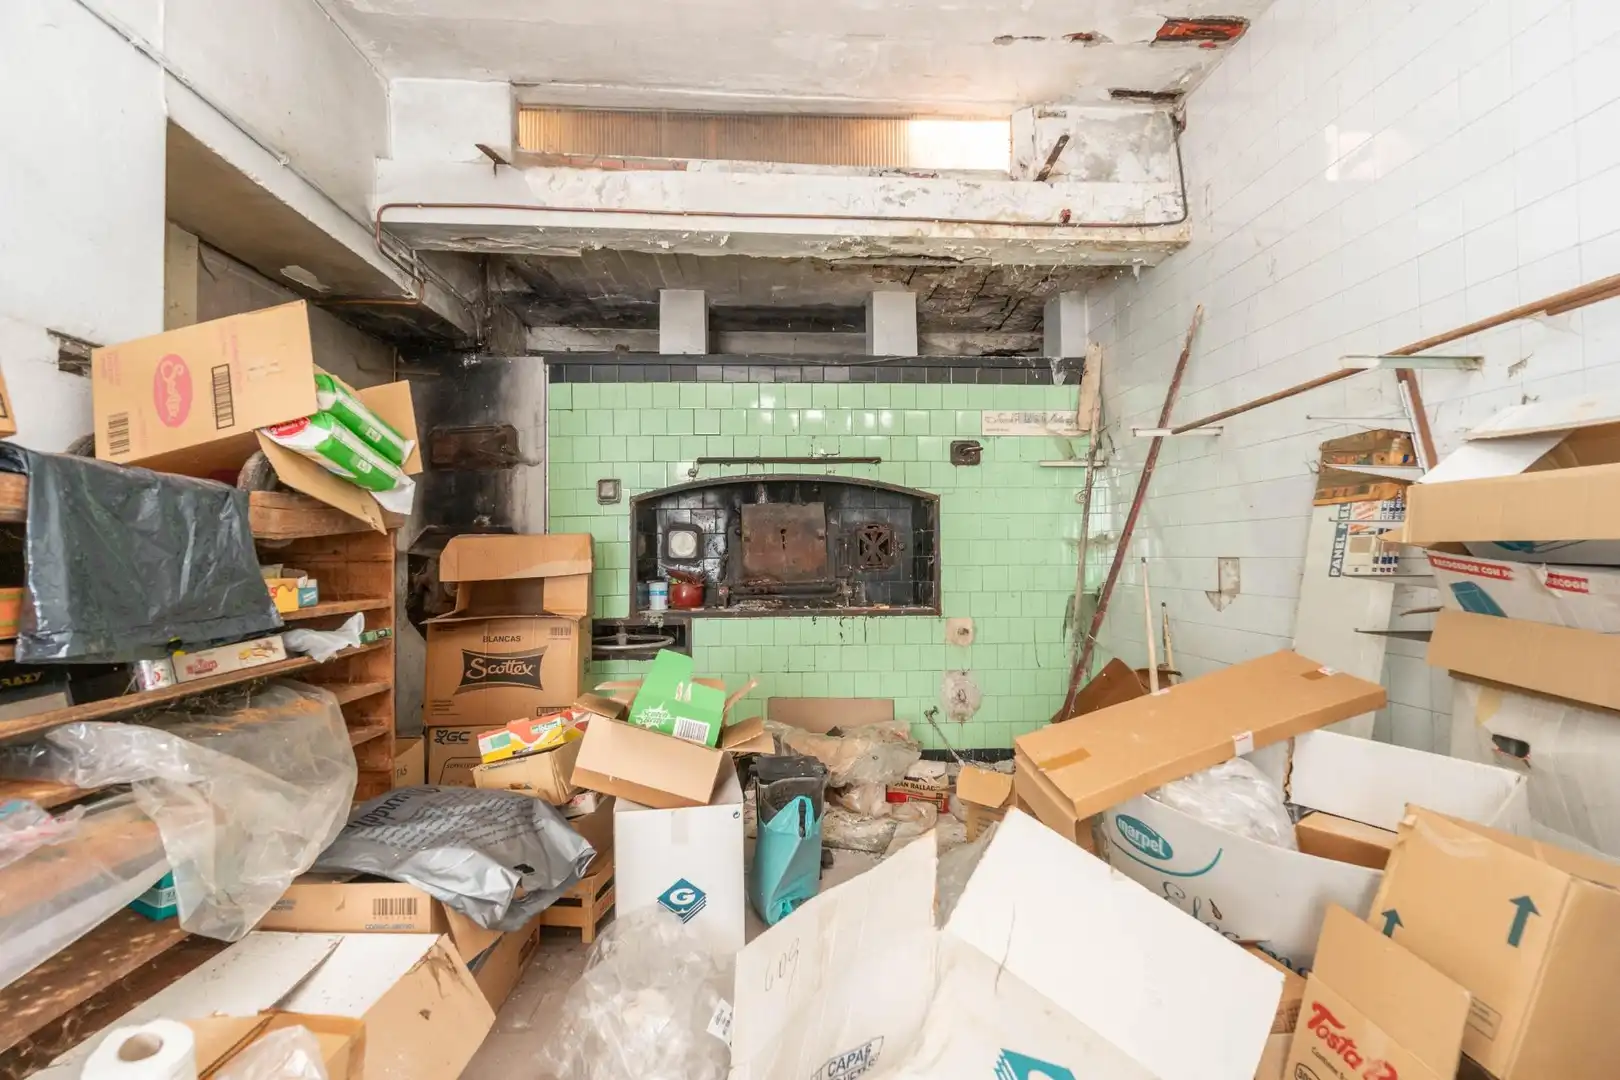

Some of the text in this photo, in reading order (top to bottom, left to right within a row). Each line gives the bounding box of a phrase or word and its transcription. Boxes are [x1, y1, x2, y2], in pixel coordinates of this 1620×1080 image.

[1331, 535, 1346, 576] PANEL
[482, 635, 522, 643] BLANCAS
[465, 657, 534, 680] Scottex
[1118, 818, 1168, 858] marpel
[1307, 1002, 1364, 1070] Tosta
